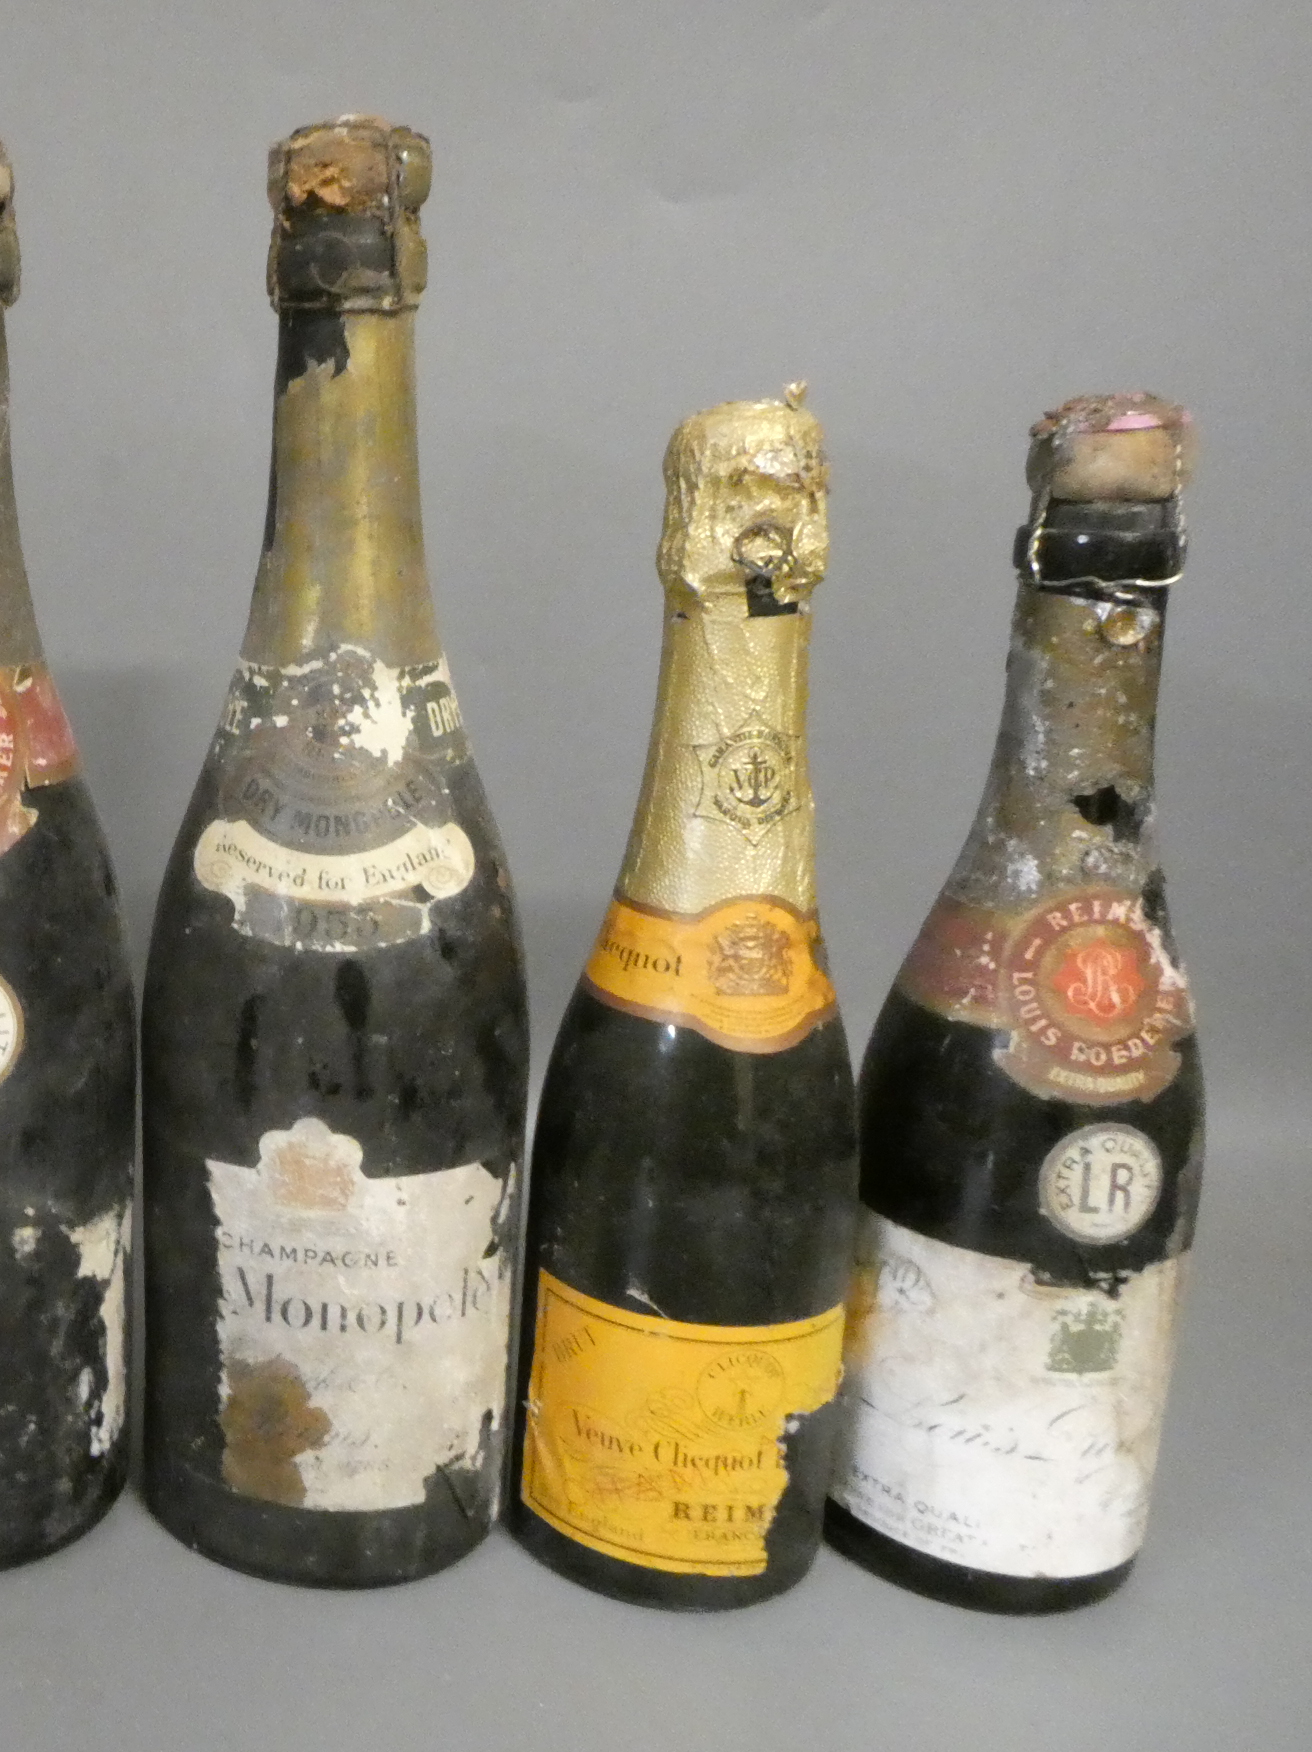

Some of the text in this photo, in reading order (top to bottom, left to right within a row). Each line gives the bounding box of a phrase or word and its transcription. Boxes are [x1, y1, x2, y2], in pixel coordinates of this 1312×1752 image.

[426, 696, 463, 737] DRY
[318, 868, 353, 892] for
[1046, 898, 1146, 930] REIMS
[1012, 970, 1062, 1047] LOUIS
[1053, 1144, 1094, 1213] EXTRA
[1077, 1160, 1134, 1215] LR
[222, 1231, 399, 1268] CHAMPAGNE
[570, 1407, 644, 1457] Veuve
[652, 1438, 765, 1477] Clicquot
